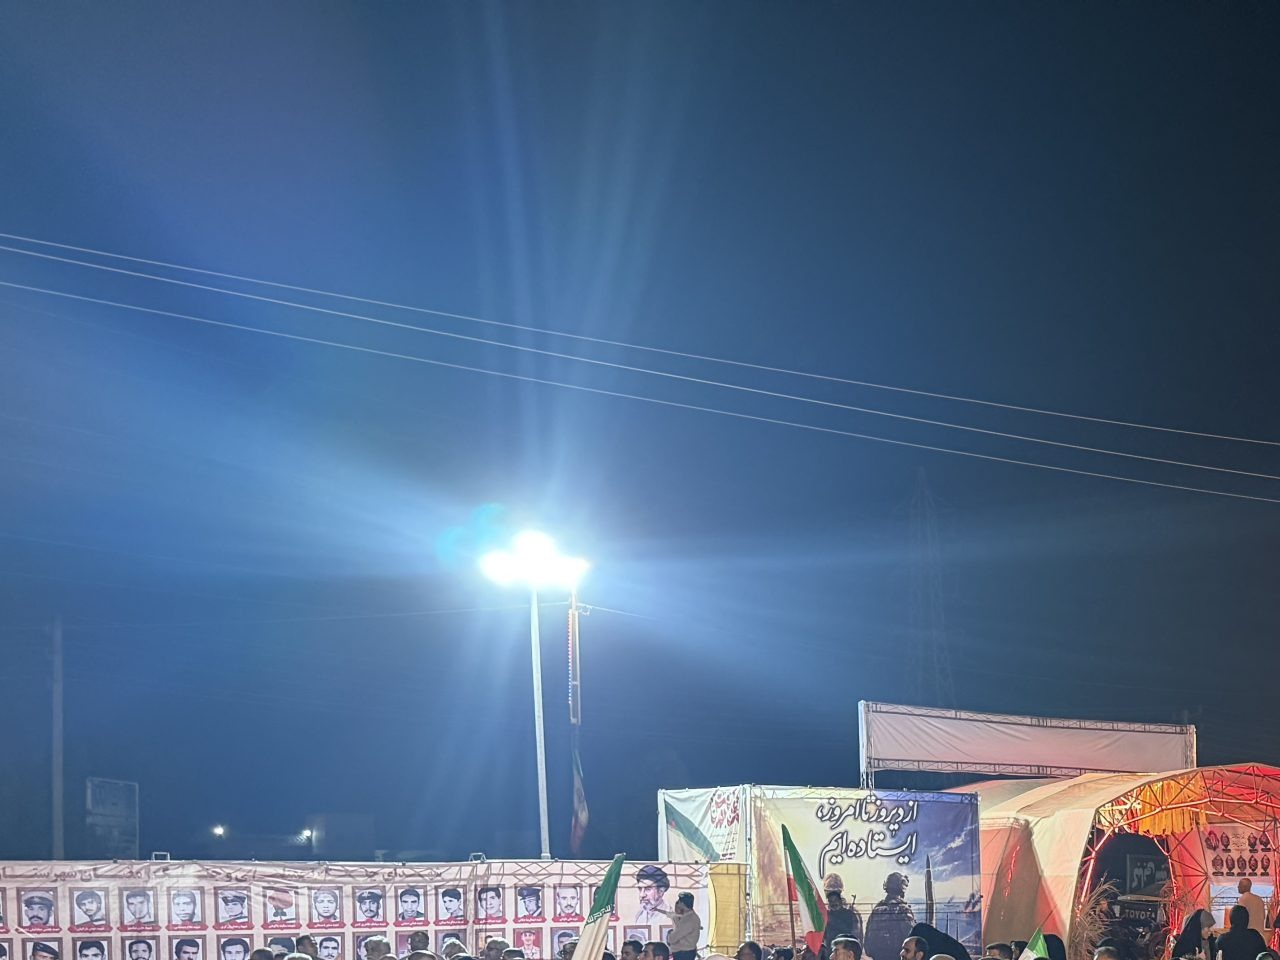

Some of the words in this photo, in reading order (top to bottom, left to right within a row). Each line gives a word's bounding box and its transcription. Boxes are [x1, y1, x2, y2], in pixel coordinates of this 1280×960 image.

[861, 795, 877, 822] تا
[868, 799, 904, 836] دیروز
[902, 799, 918, 823] از
[0, 866, 77, 882] شهرستا
[1125, 909, 1156, 919] TOYOTA
